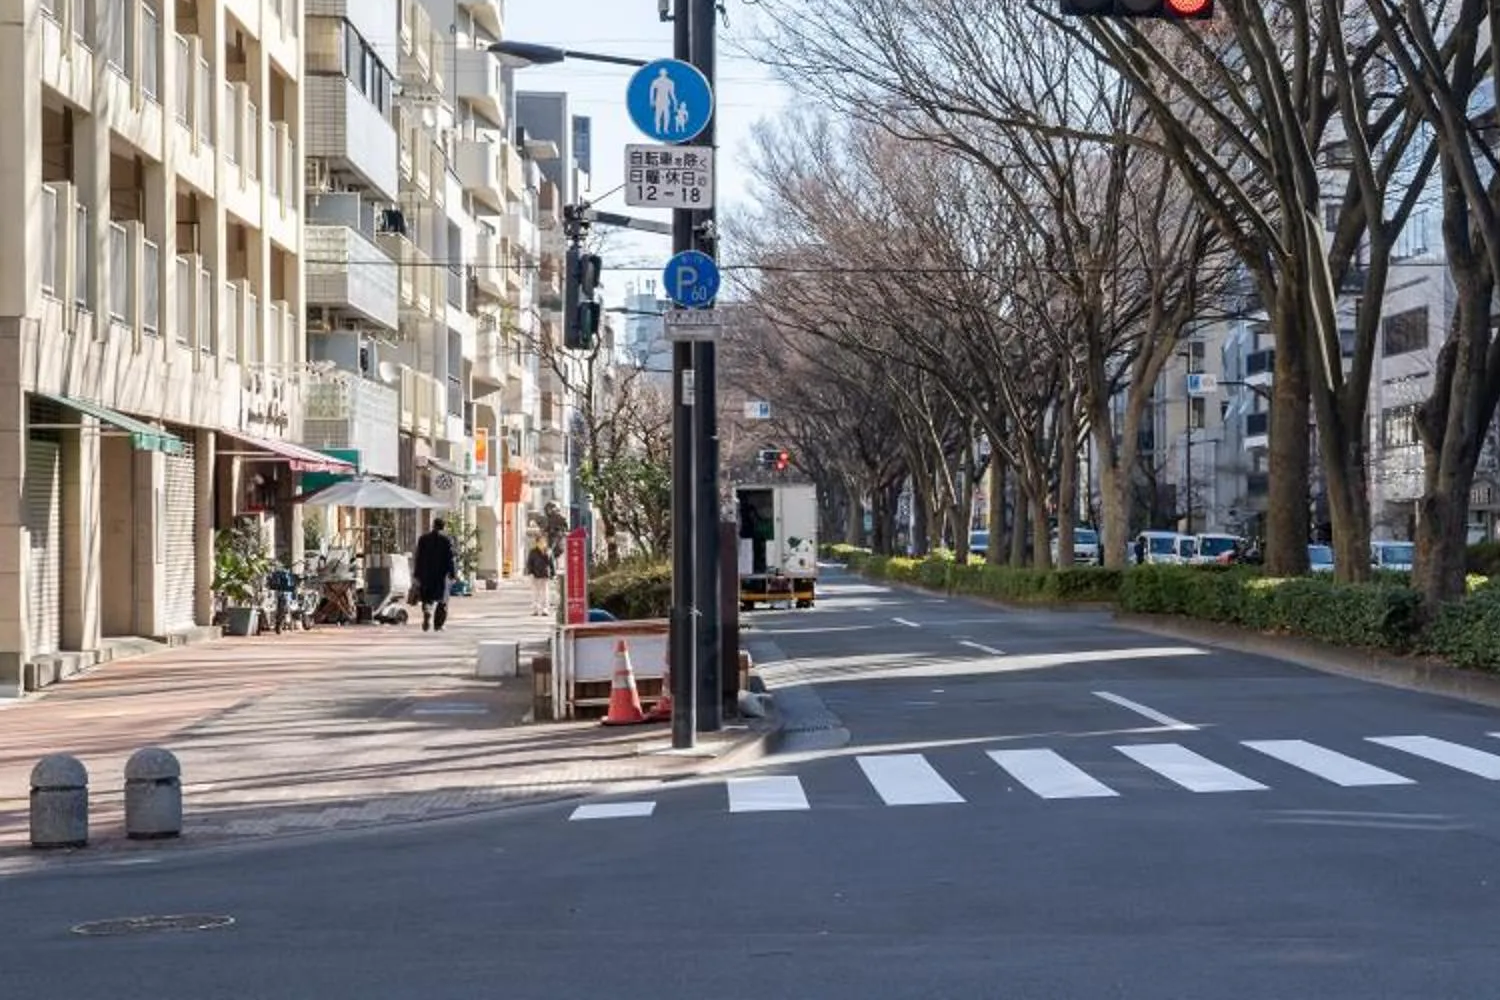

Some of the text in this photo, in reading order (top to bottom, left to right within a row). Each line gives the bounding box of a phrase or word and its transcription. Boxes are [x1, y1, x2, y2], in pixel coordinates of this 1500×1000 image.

[630, 150, 707, 168] 自転車を除く
[677, 265, 698, 301] P
